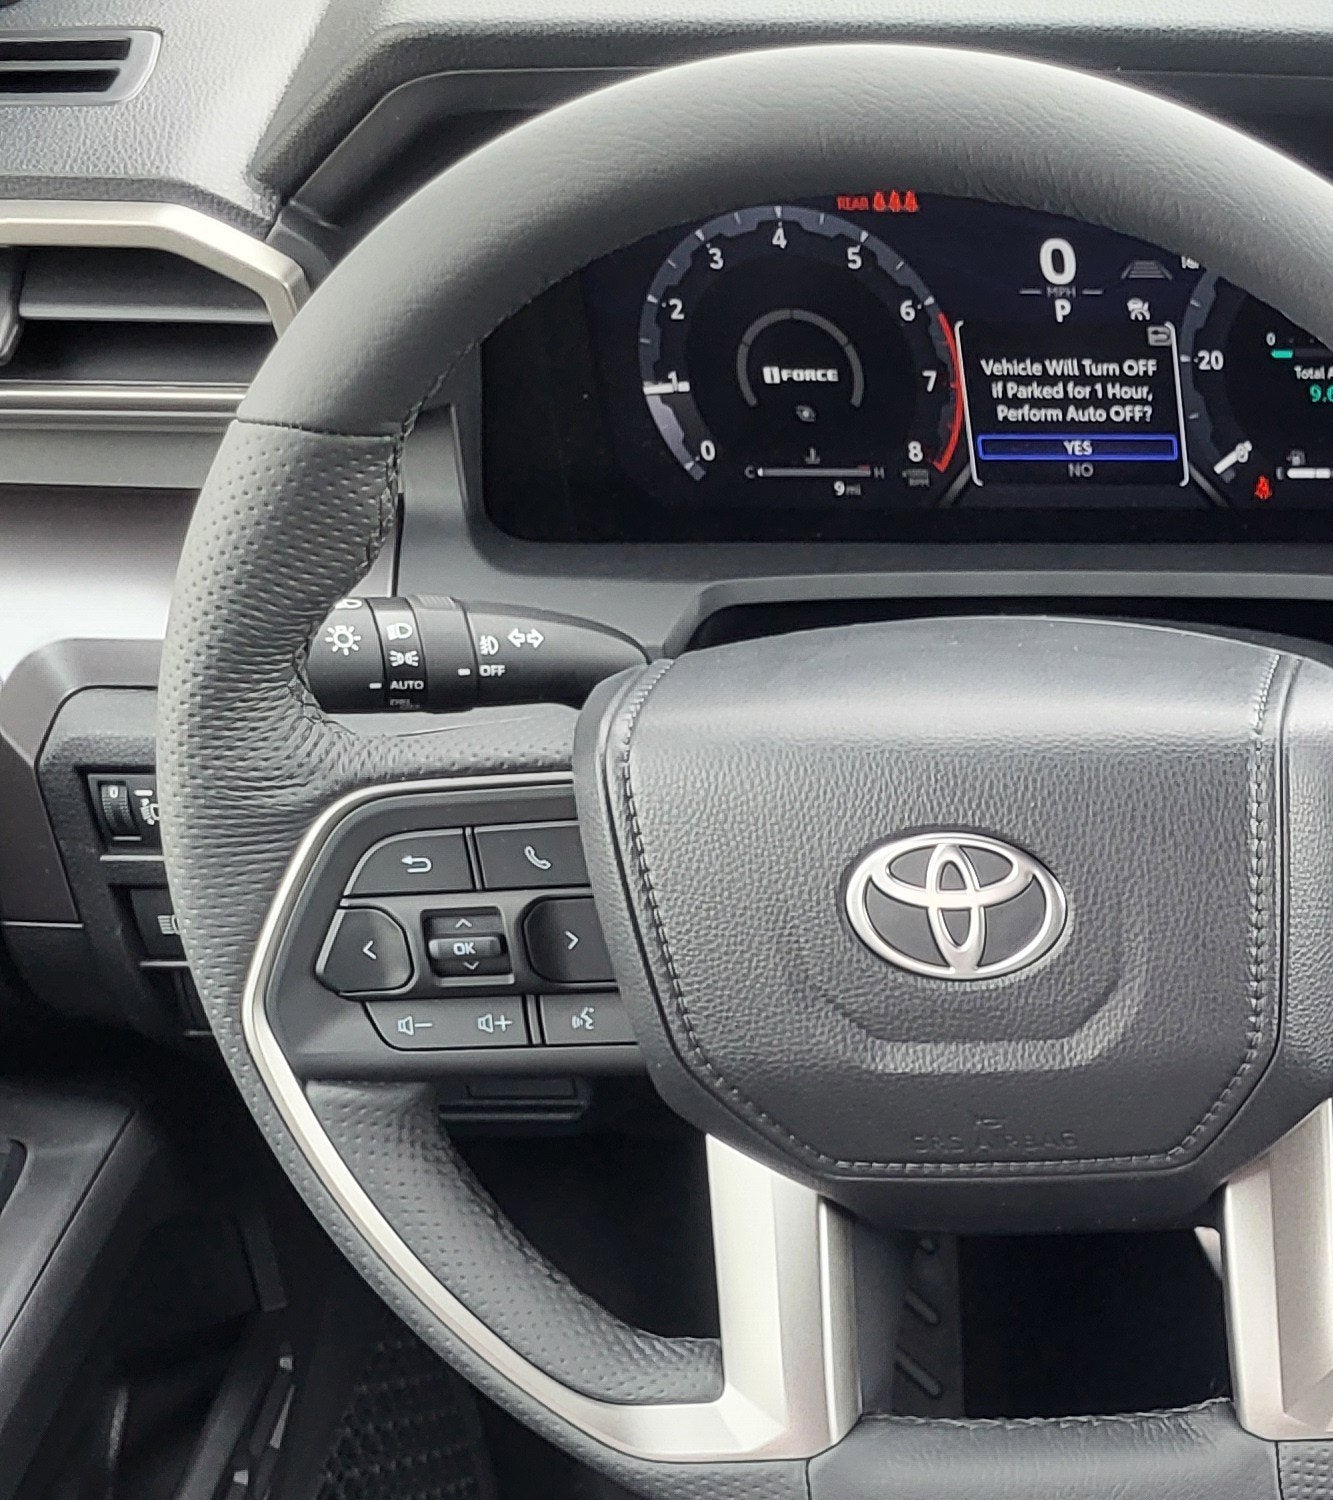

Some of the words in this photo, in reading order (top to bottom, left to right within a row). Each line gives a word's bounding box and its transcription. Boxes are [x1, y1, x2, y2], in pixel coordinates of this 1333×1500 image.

[772, 228, 787, 248] 4
[709, 248, 724, 269] 3
[847, 248, 862, 269] 5
[1040, 238, 1077, 285] 0
[1047, 287, 1076, 298] MPH
[668, 299, 685, 320] 2
[900, 300, 915, 321] 6
[1054, 298, 1072, 322] P
[1266, 332, 1276, 346] 0
[980, 357, 1043, 376] Vehicle
[1044, 358, 1079, 376] Will
[1081, 359, 1120, 376] Turn
[1122, 359, 1157, 376] OFF
[1198, 350, 1224, 371] 20
[922, 370, 937, 392] 7
[1294, 365, 1325, 380] Total
[991, 381, 1004, 399] If
[1006, 381, 1064, 399] Parked
[1066, 381, 1092, 399] for
[1094, 382, 1103, 399] 1
[1106, 382, 1153, 402] Hour,
[996, 404, 1063, 422] Perform
[1066, 404, 1107, 422] Auto
[1109, 405, 1153, 422] OFF?
[700, 440, 716, 461] 0
[908, 441, 924, 462] 8
[1063, 440, 1093, 456] YES
[1068, 462, 1094, 477] NO
[479, 665, 506, 677] OFF
[390, 680, 425, 690] AUTO
[453, 942, 476, 955] OK
